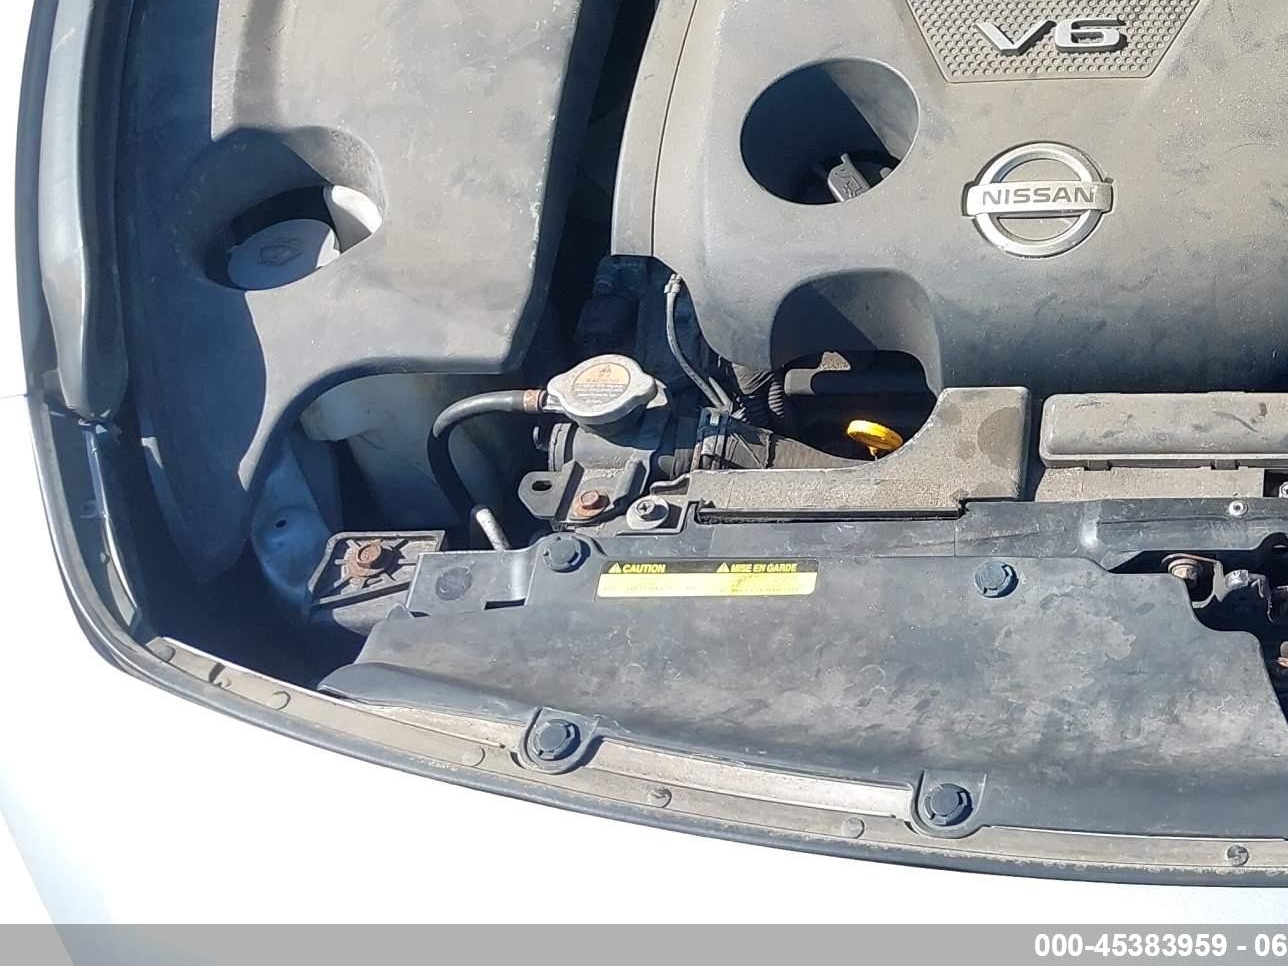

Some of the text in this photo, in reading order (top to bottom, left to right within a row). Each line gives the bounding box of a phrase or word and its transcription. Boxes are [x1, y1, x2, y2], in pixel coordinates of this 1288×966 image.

[975, 18, 1126, 56] V6
[982, 186, 1094, 206] NISSAN
[623, 563, 798, 573] CAUTION MISE EN GARDE
